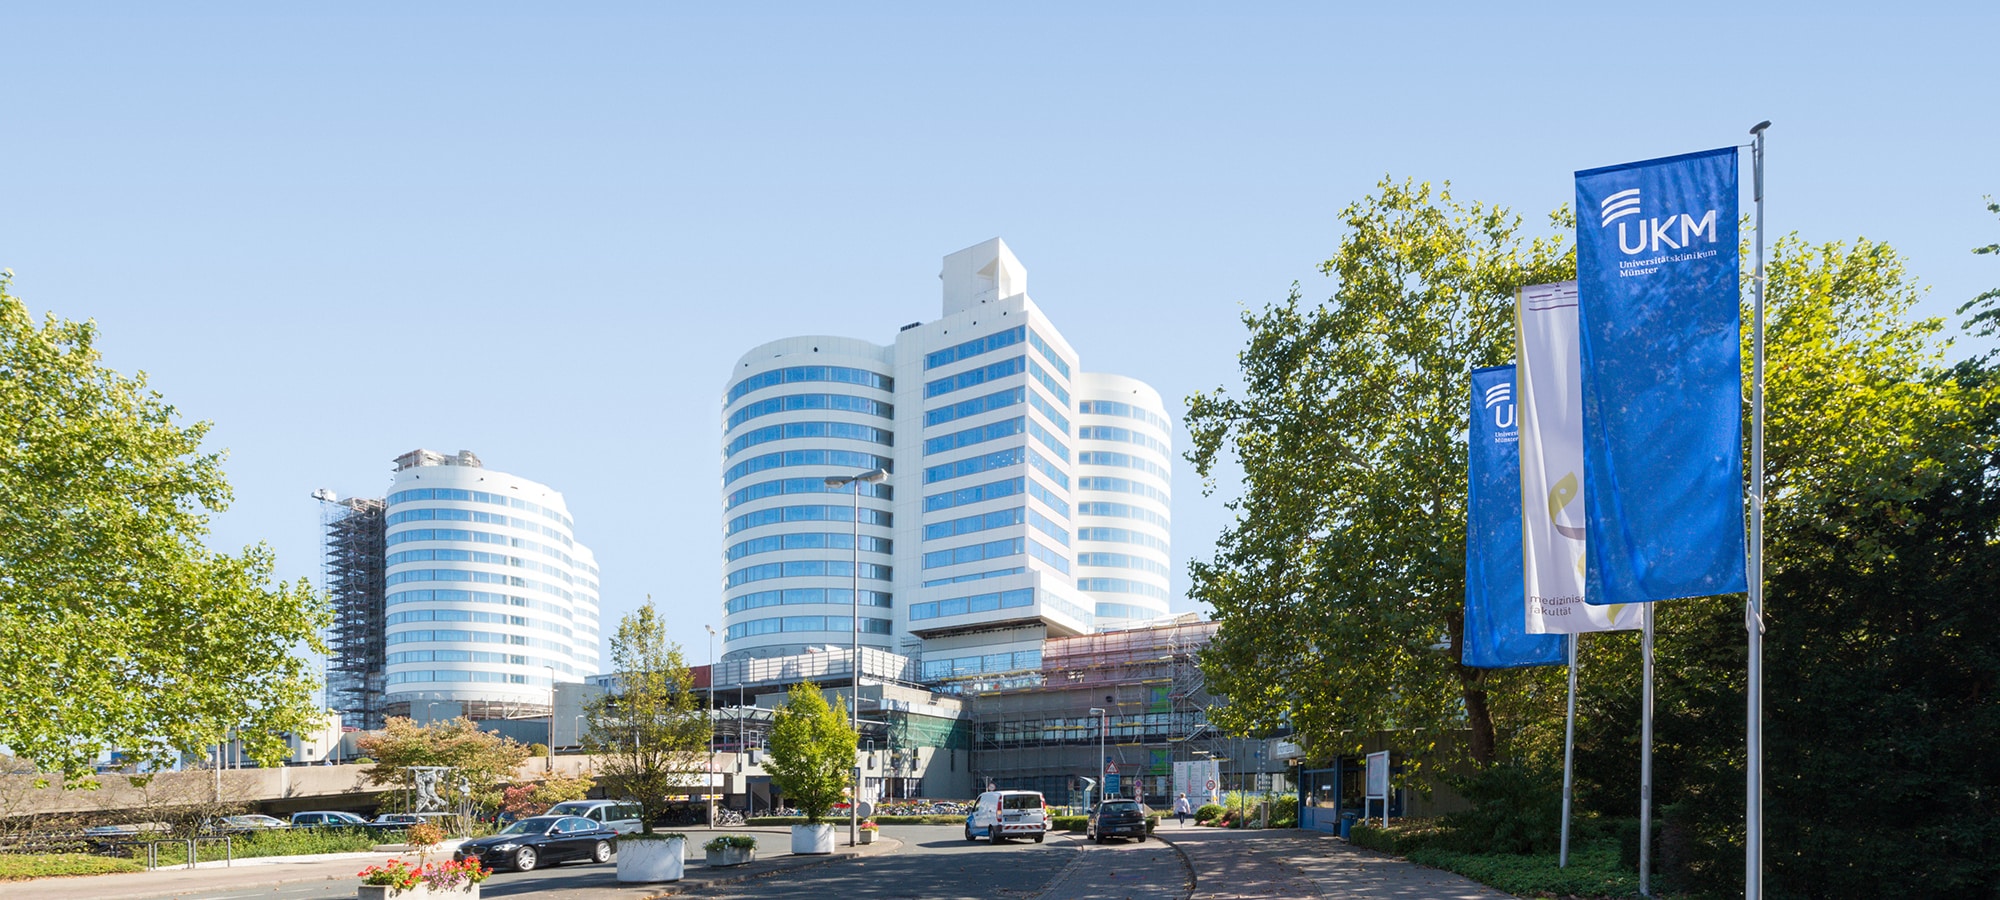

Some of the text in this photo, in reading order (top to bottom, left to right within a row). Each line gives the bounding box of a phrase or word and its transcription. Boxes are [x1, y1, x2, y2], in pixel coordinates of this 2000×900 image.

[1619, 210, 1717, 255] UKM
[1619, 249, 1717, 269] Universitätsklinikum
[1620, 267, 1659, 278] Münster
[1496, 404, 1518, 428] U
[1530, 606, 1571, 616] fakultät
